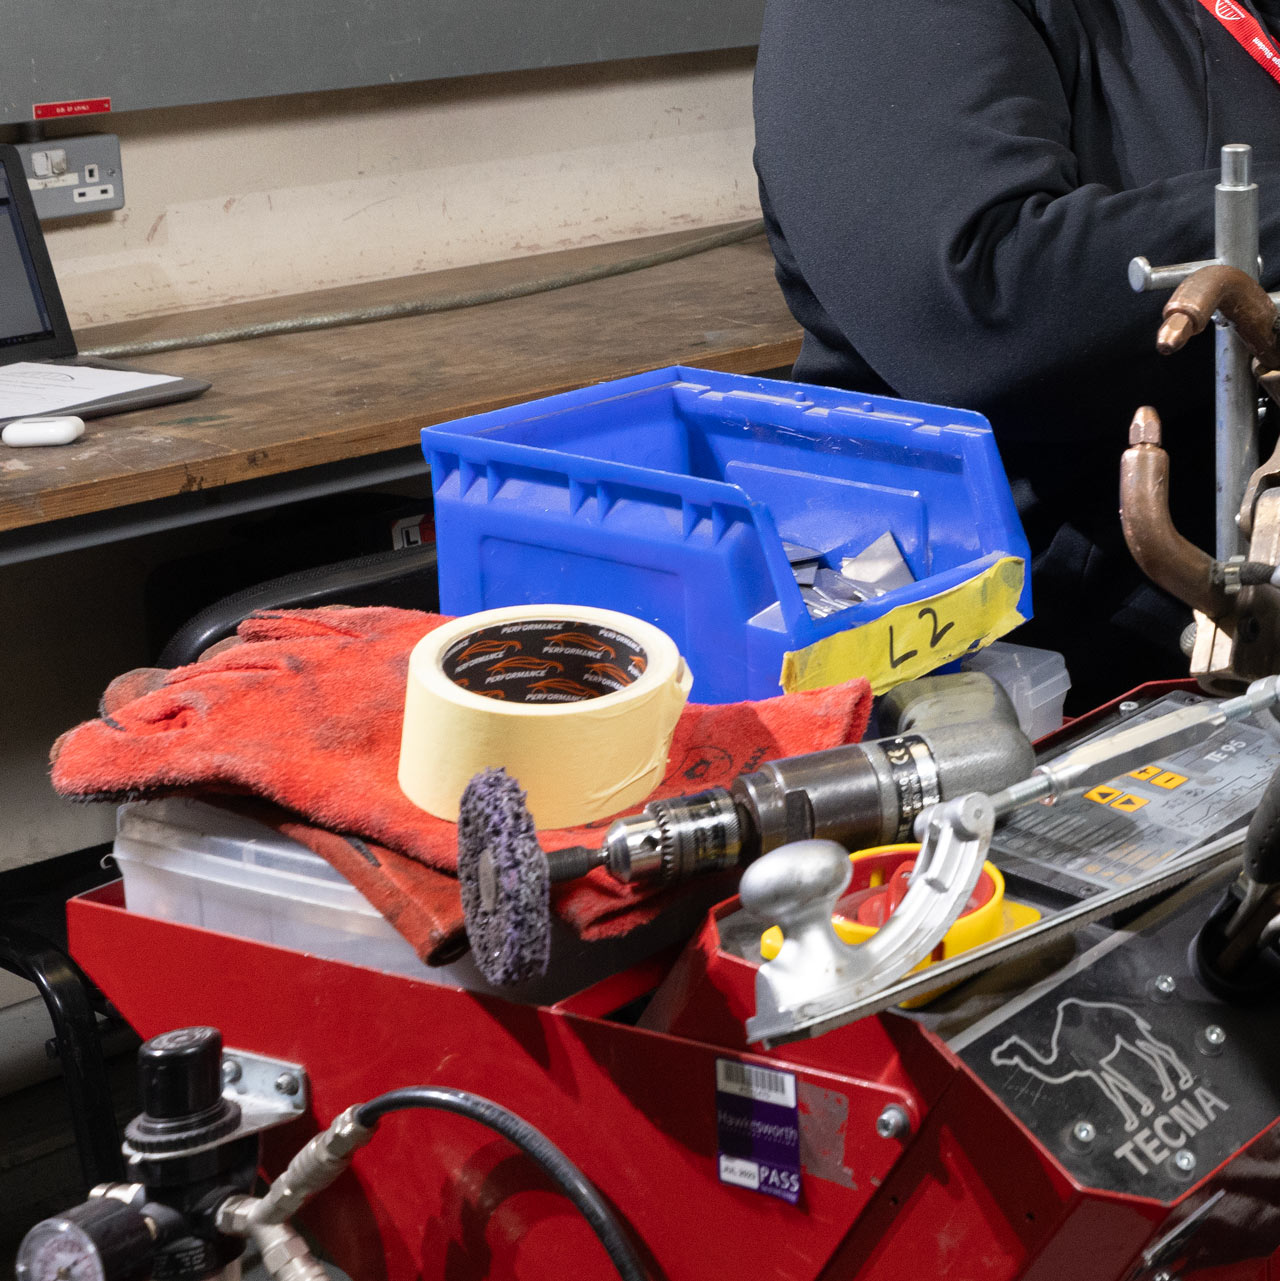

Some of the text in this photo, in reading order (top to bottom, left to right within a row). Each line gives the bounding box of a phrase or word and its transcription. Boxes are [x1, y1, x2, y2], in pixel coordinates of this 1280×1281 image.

[1251, 37, 1272, 61] Student
[501, 623, 565, 634] PERFORMANCE
[542, 646, 602, 659] PERFORMANCE
[485, 670, 547, 685] PERFORMANCE
[1203, 739, 1248, 764] TE 95
[1114, 1086, 1230, 1176] TECNA
[760, 1166, 800, 1193] PASS
